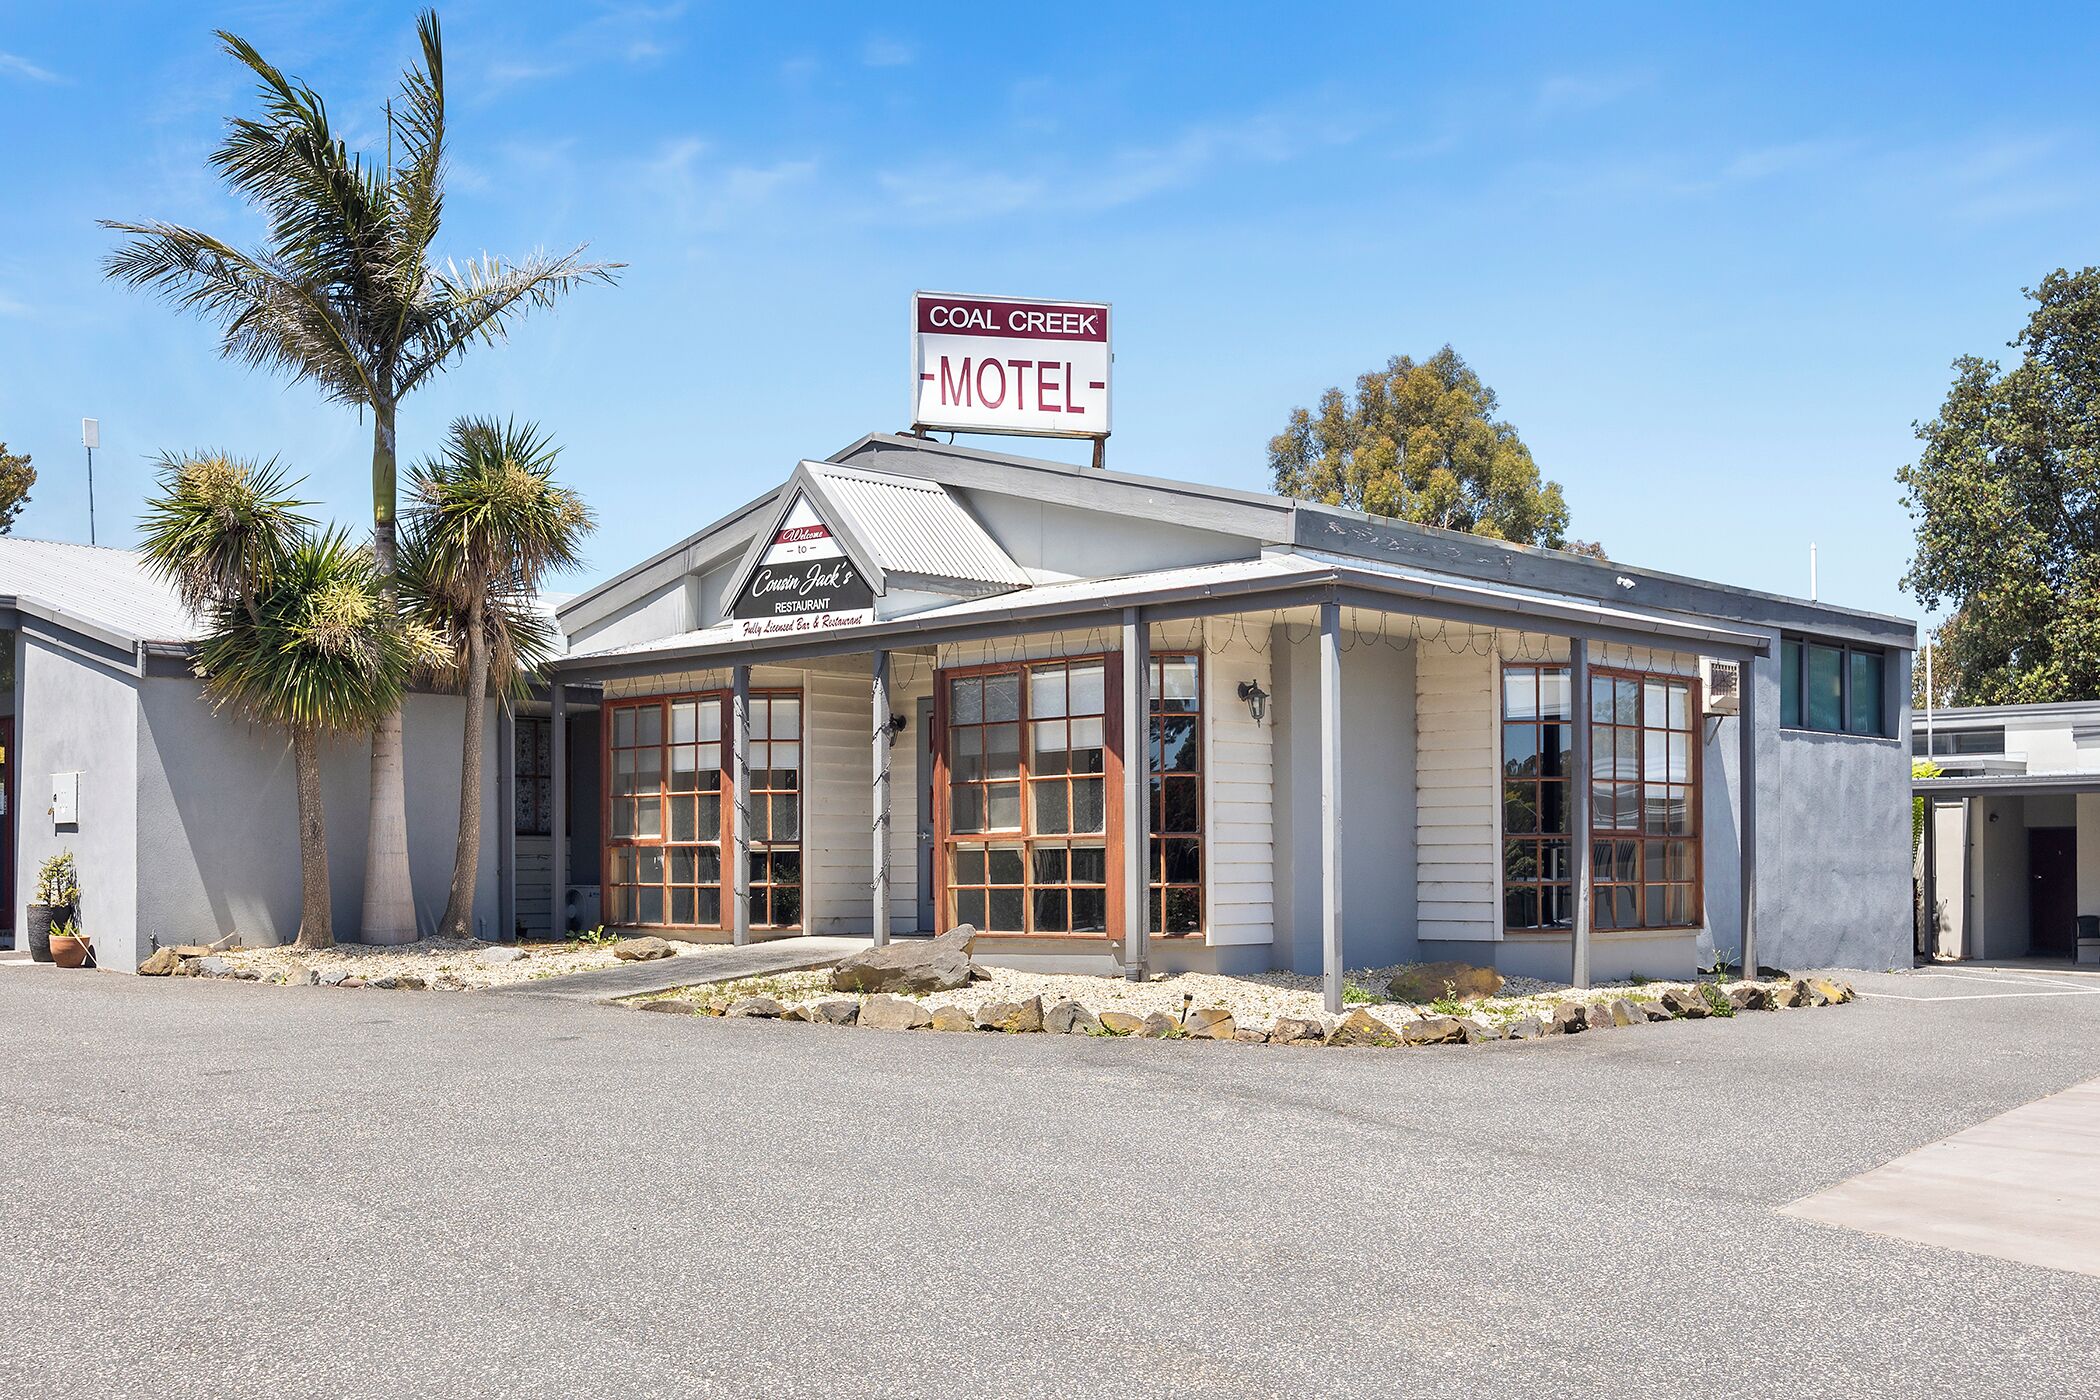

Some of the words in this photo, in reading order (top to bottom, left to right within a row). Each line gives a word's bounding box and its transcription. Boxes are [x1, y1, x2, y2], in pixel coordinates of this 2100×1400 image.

[929, 305, 1000, 330] COAL
[1008, 310, 1097, 335] CREEK
[783, 528, 824, 542] Welcome
[752, 569, 800, 597] Cousin
[799, 561, 853, 596] Jack's
[775, 598, 830, 613] RESTAURANT
[743, 621, 762, 637] Fully
[763, 620, 794, 633] Licensed
[797, 617, 810, 630] Bar
[813, 615, 819, 629] &
[822, 614, 862, 628] Restaurant
